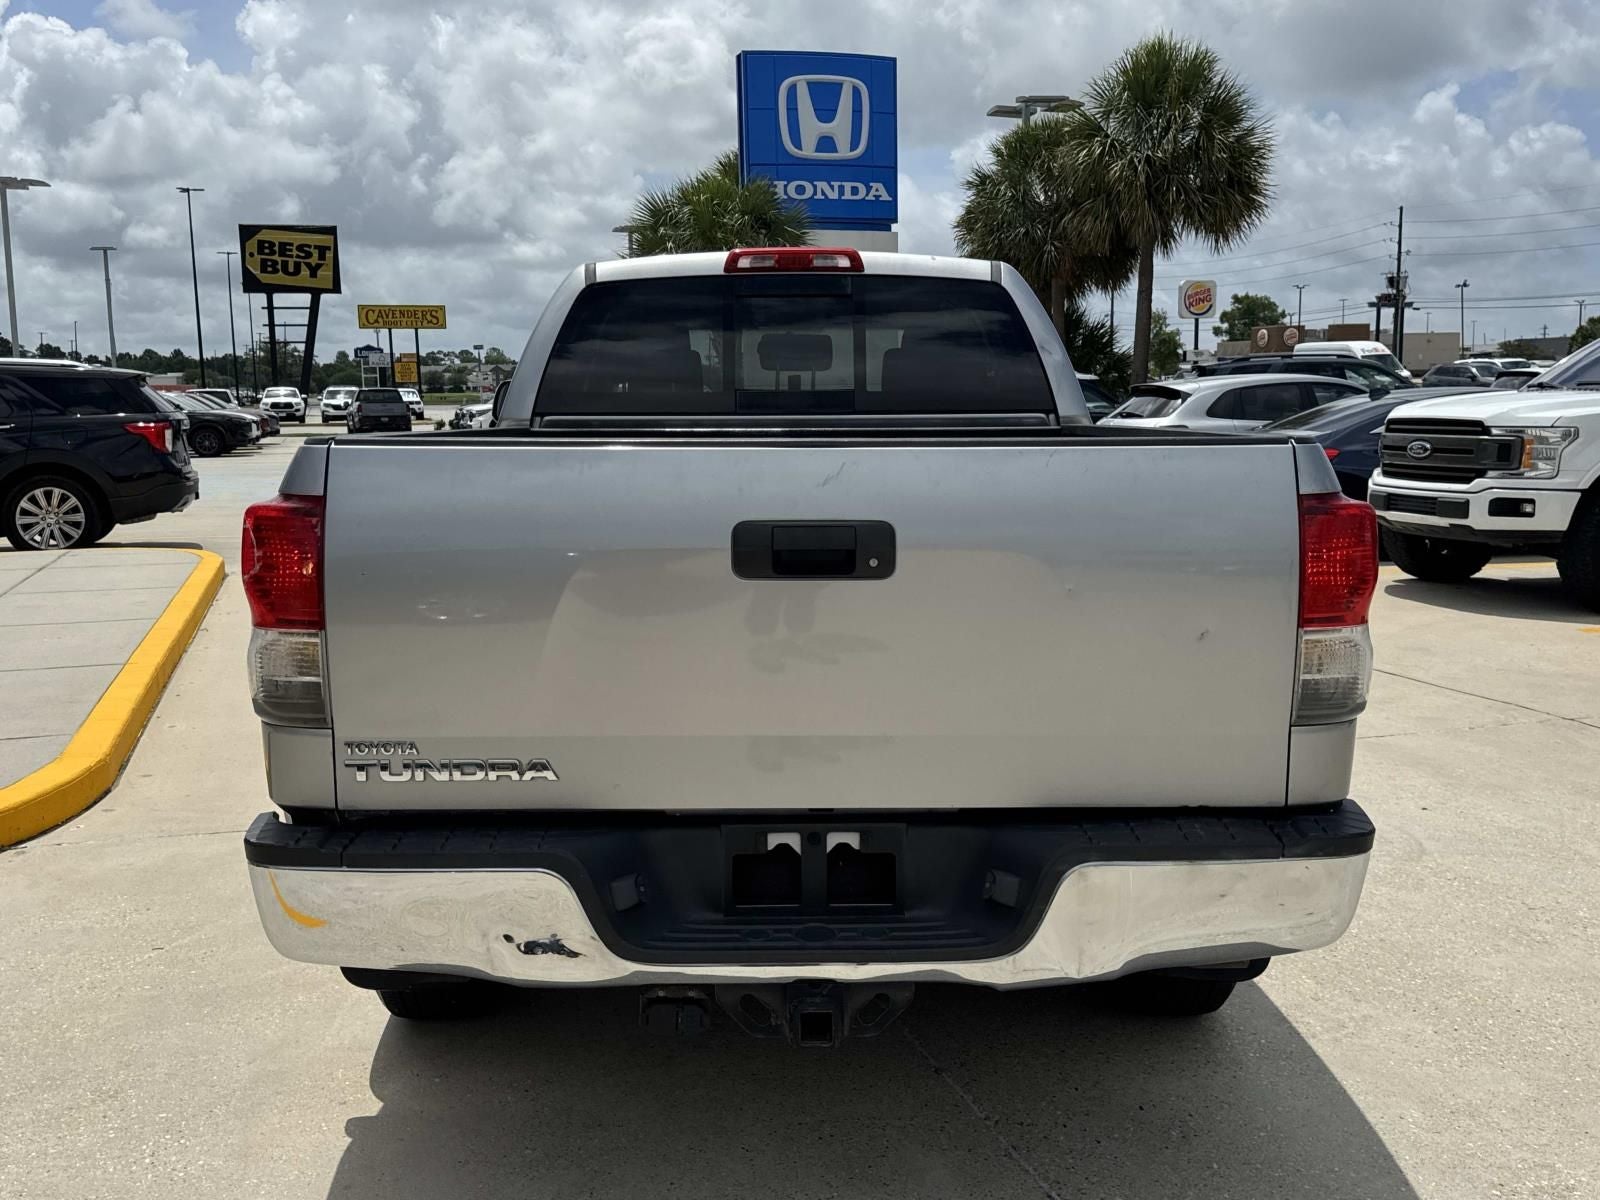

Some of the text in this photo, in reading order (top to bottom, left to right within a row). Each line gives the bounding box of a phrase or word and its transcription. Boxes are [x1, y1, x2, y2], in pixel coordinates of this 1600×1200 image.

[257, 239, 331, 262] BEST
[260, 257, 325, 279] BUY
[1188, 294, 1212, 309] KING
[365, 309, 440, 325] CAVENDER'S
[344, 741, 418, 755] TOYOTA
[344, 759, 559, 782] TUNDRA
